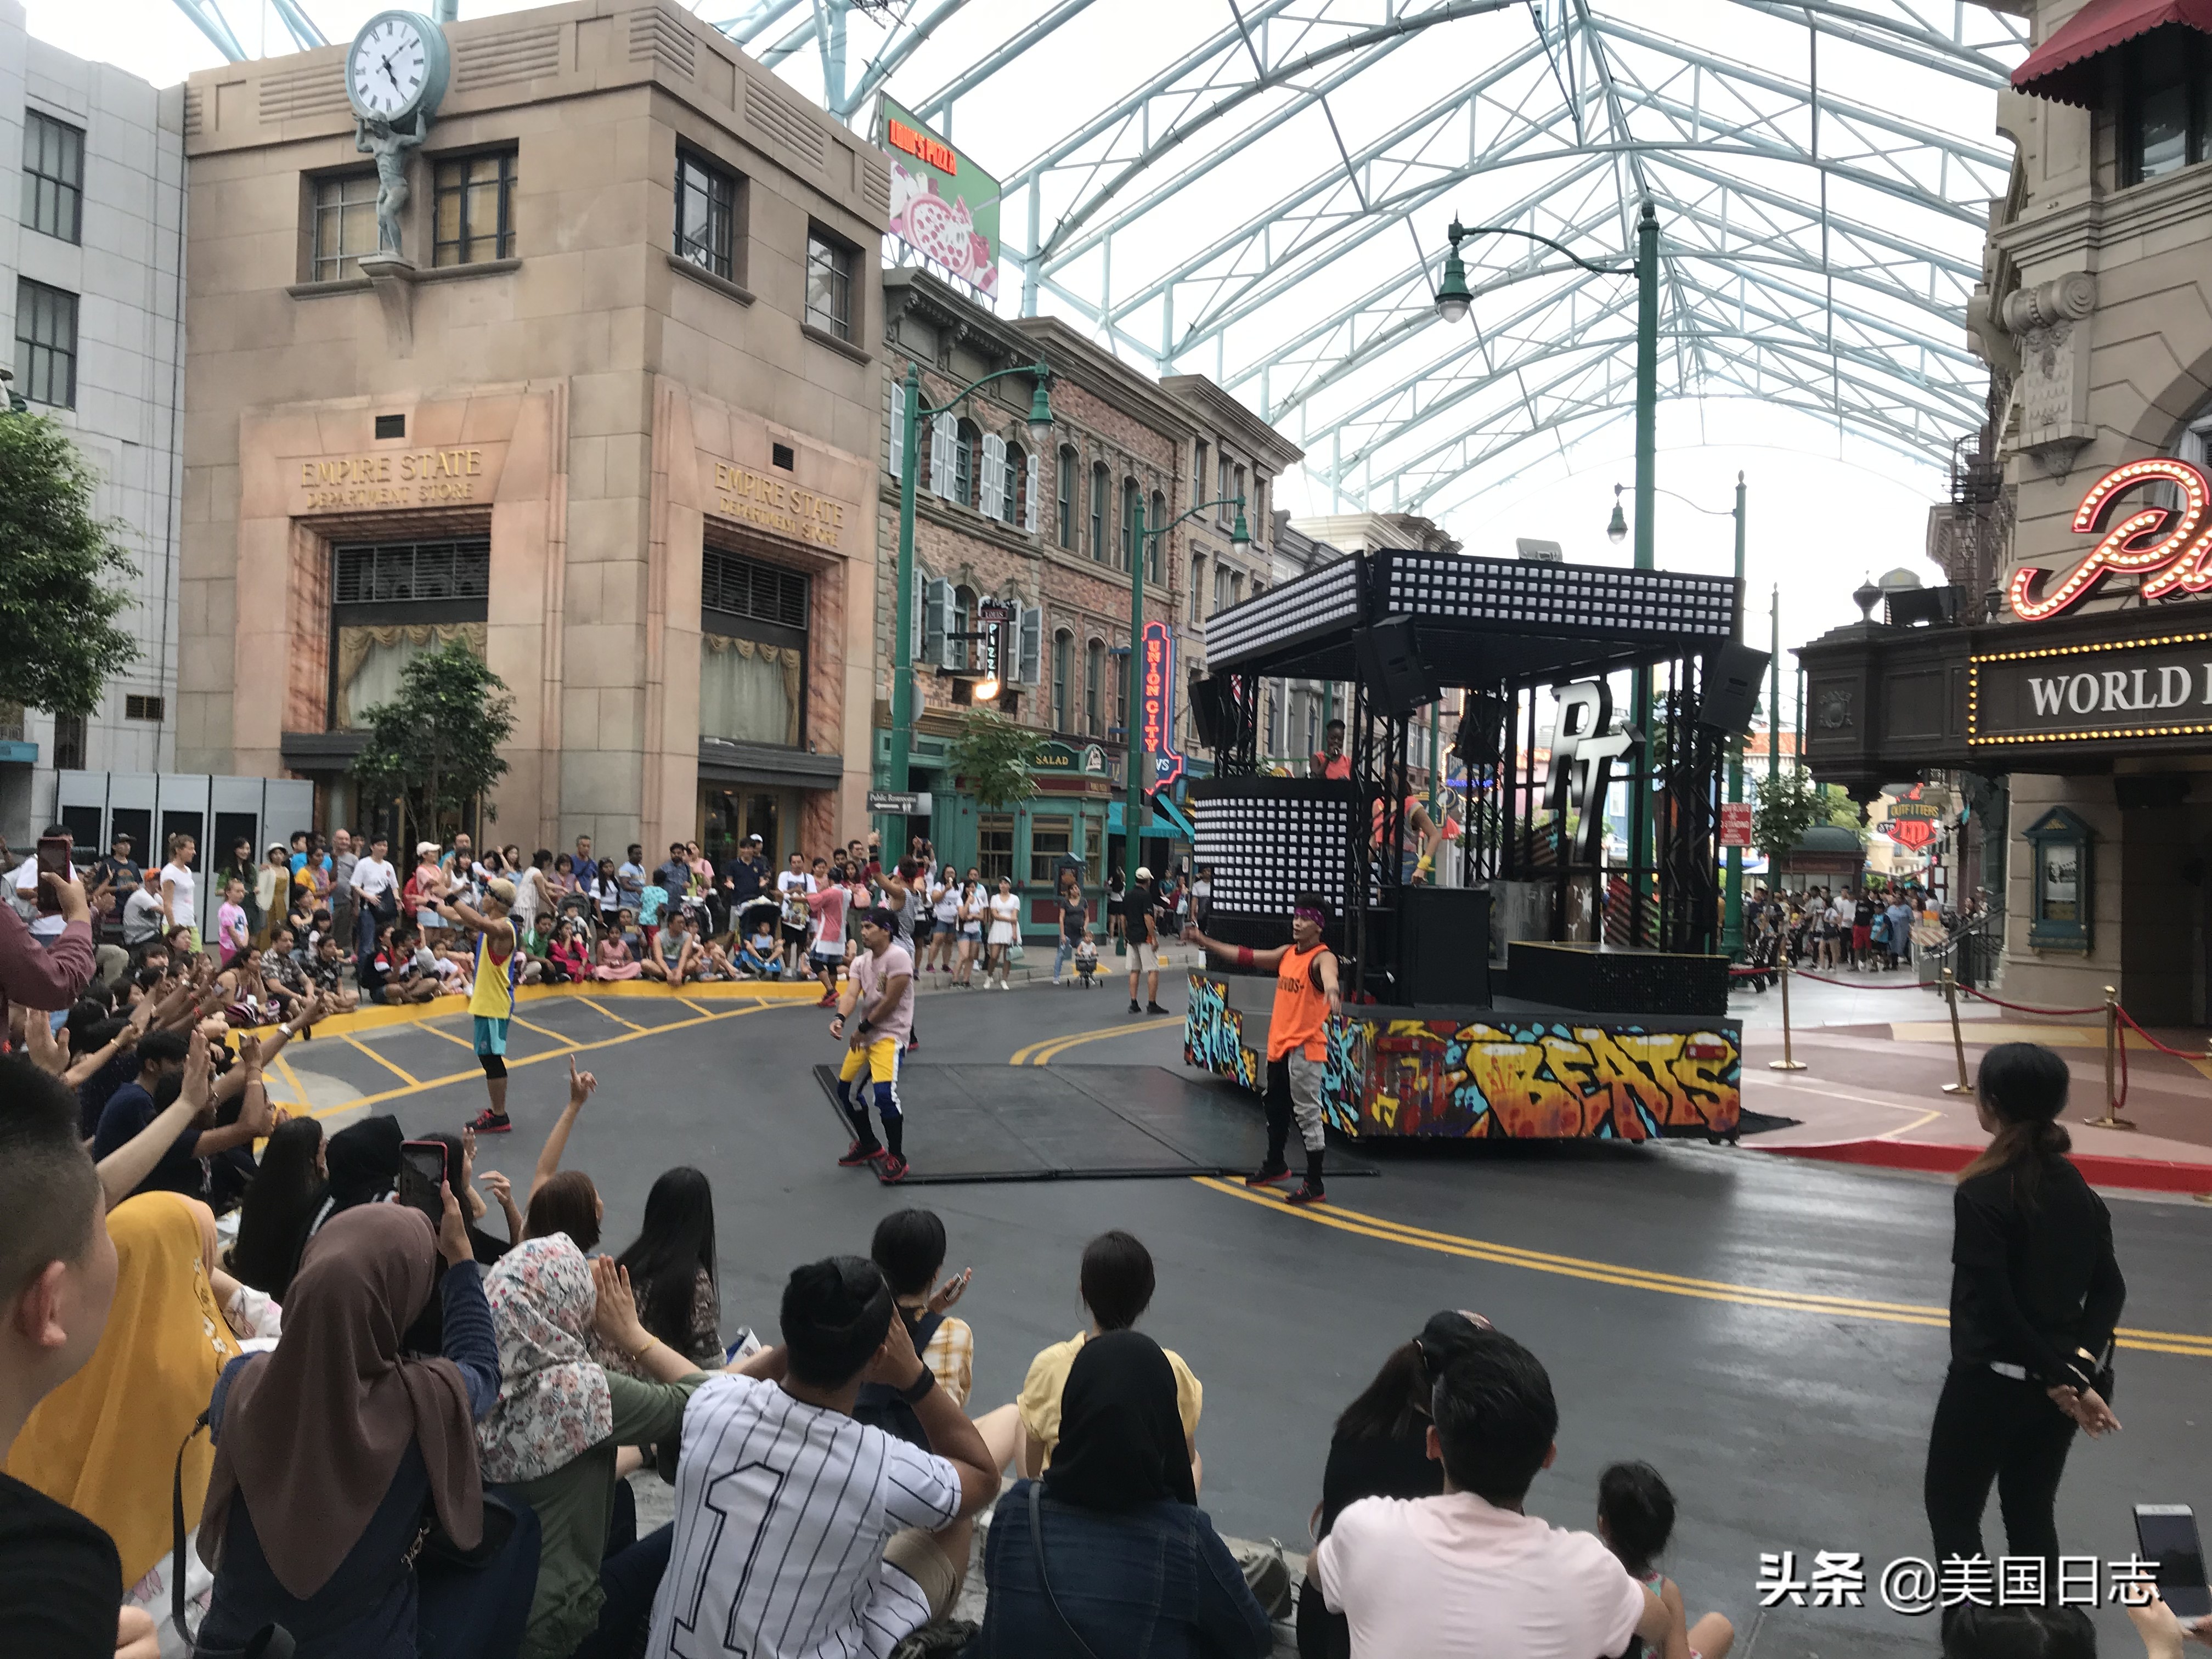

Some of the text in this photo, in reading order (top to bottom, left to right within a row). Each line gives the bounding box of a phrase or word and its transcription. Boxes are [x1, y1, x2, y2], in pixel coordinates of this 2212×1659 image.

[926, 137, 957, 176] PIZZA
[301, 449, 482, 488] EMPIRE STATE
[307, 483, 474, 509] DEPARTMENT STORE
[714, 462, 844, 530] EMPIRE STATE
[719, 496, 838, 548] DEPARTMENT STORE
[987, 623, 998, 681] PIZZA
[1144, 640, 1161, 752] UNION CITY
[2028, 665, 2193, 716] WORLD
[1035, 755, 1069, 766] SALAD
[1891, 804, 1939, 817] OUTFITTERS
[1900, 821, 1929, 844] LTD
[1455, 1023, 1740, 1139] BEATS
